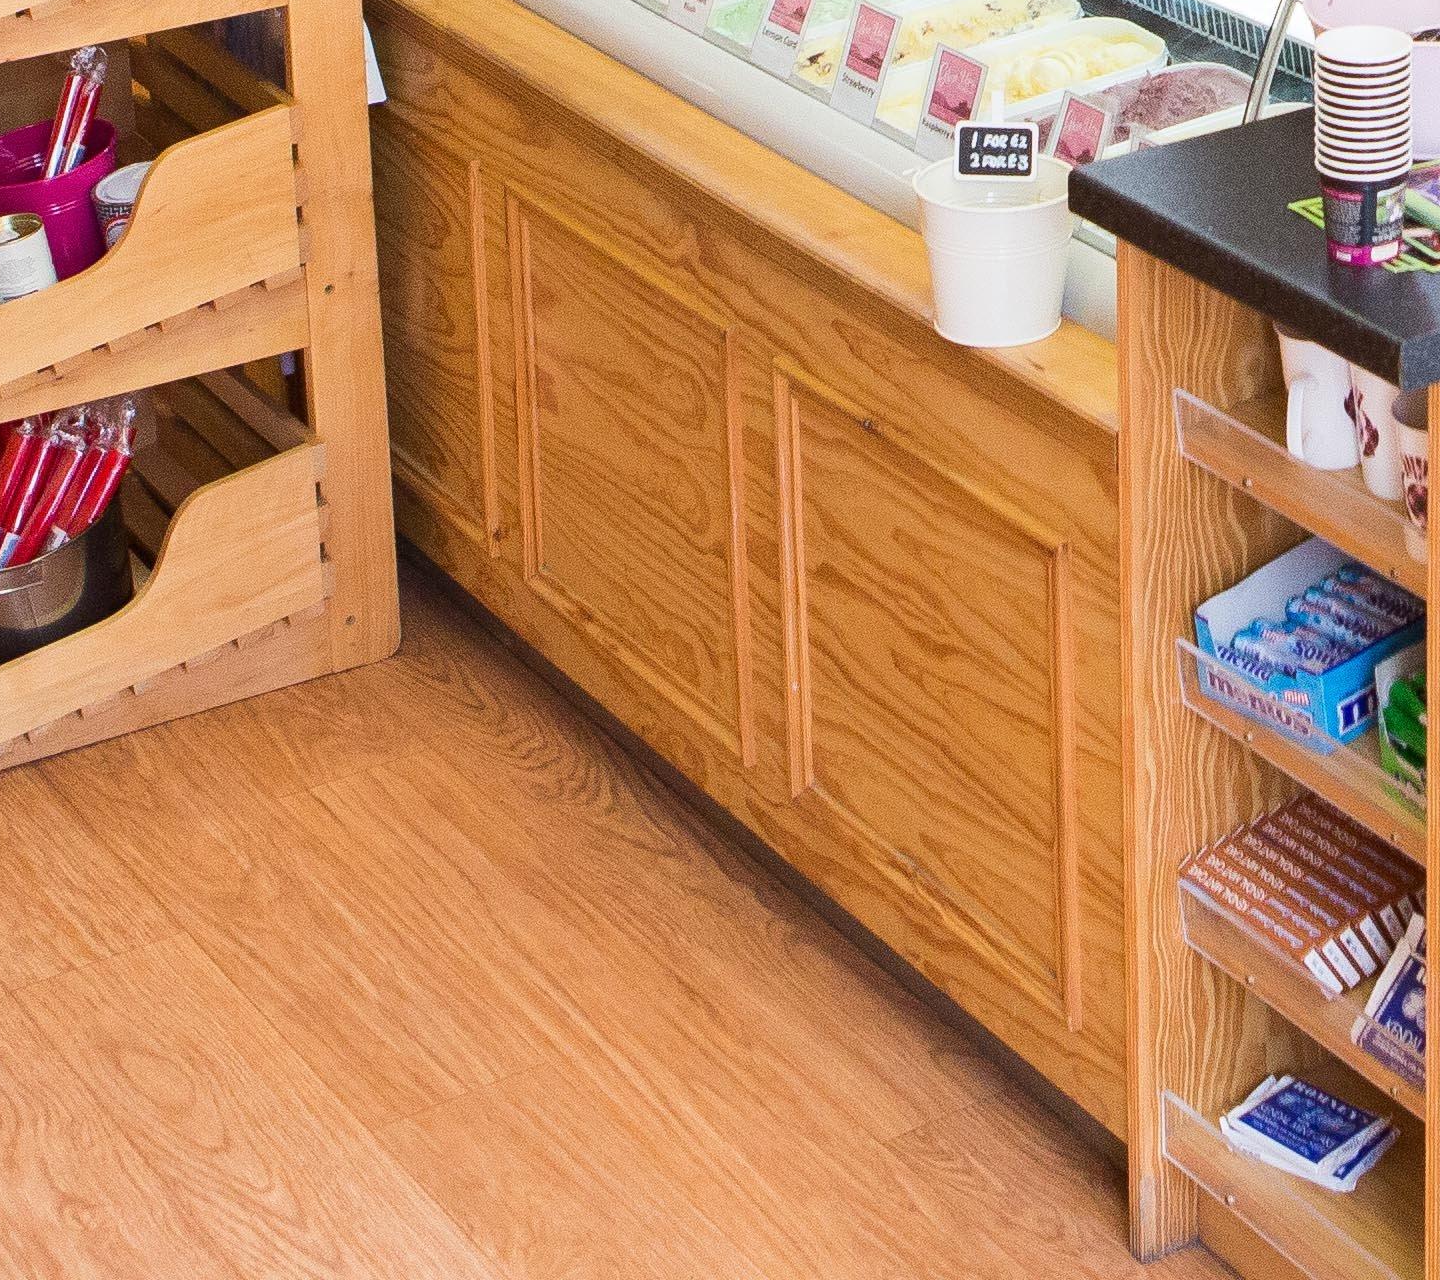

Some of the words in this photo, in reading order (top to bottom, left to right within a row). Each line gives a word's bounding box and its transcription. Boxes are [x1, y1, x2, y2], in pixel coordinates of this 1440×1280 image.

[841, 70, 876, 100] Strawberry
[970, 132, 978, 150] 1
[982, 133, 1009, 150] FOR
[1284, 690, 1310, 705] mint
